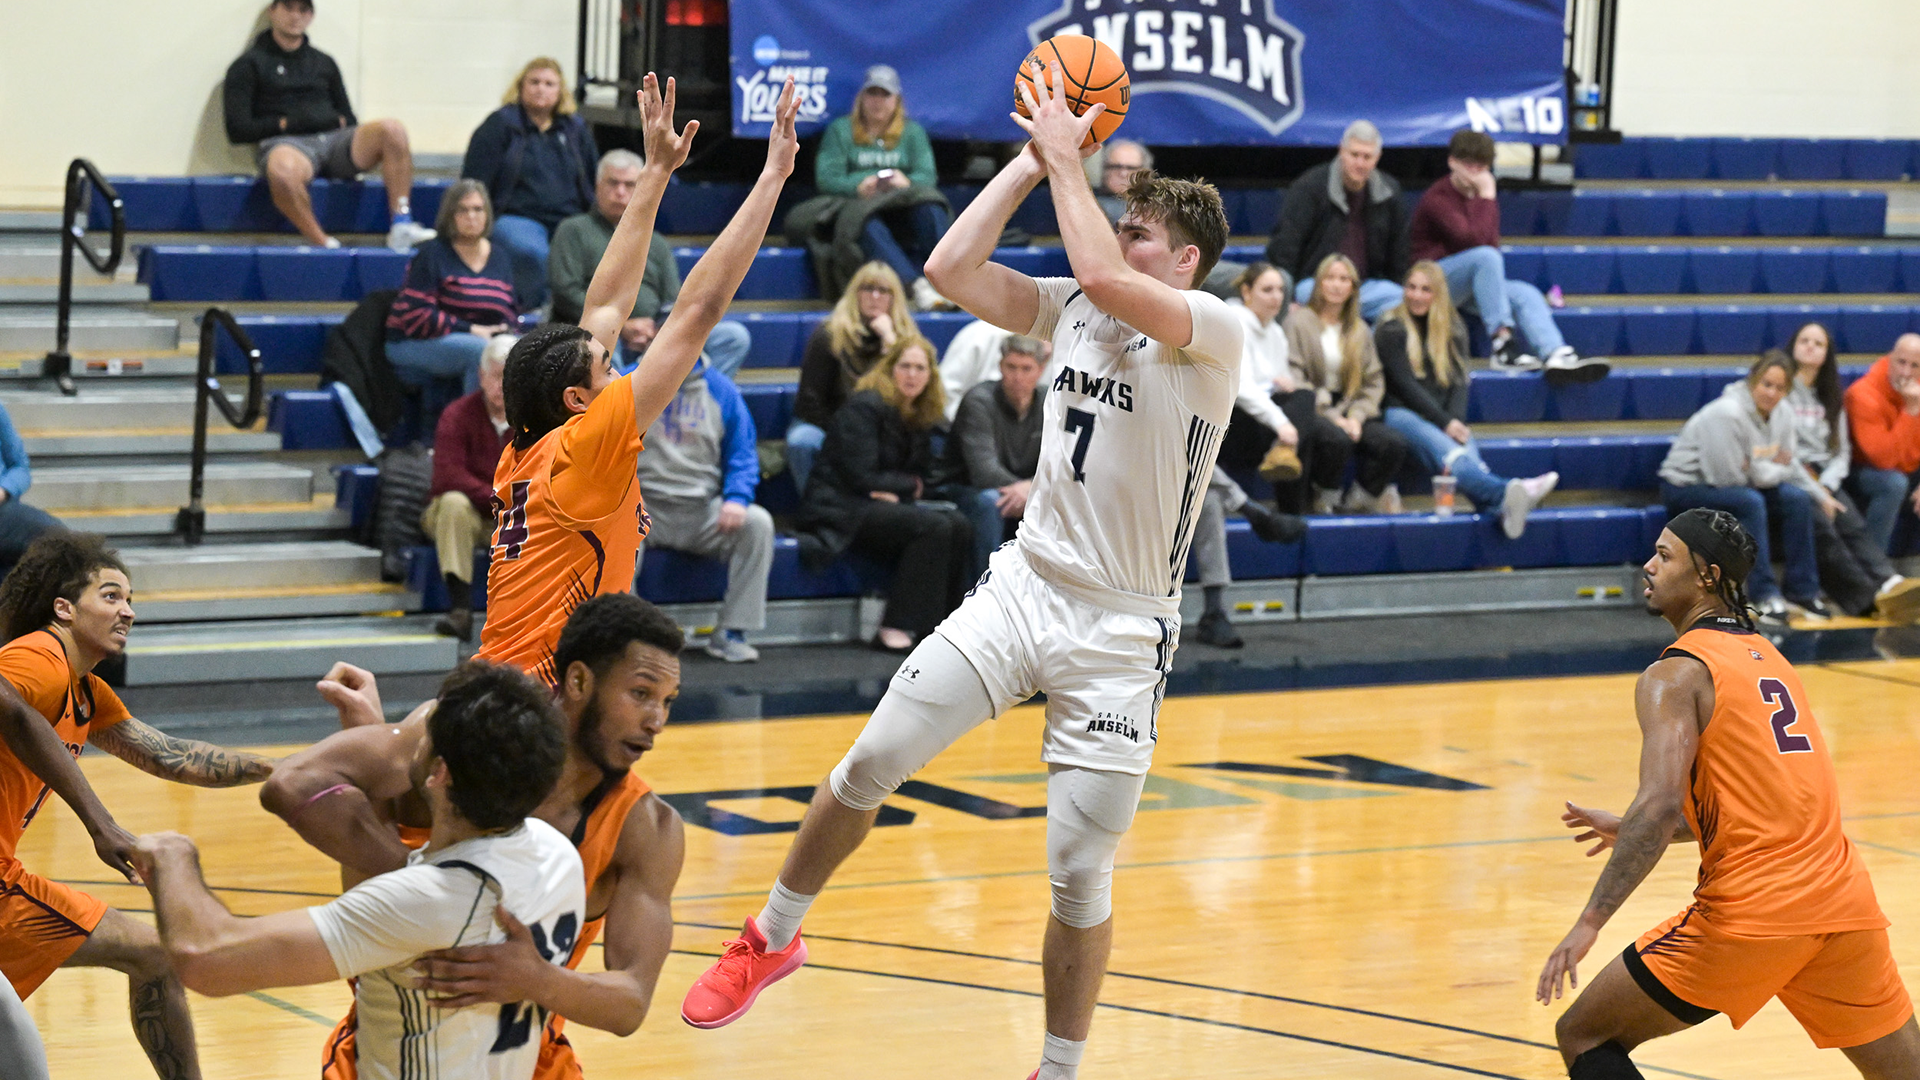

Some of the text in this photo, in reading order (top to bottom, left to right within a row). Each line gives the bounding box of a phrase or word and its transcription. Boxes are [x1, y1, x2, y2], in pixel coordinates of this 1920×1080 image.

[1054, 10, 1291, 106] NSELM
[1063, 406, 1096, 486] 7
[1086, 719, 1139, 744] ANSELM
[1097, 711, 1135, 726] SAINT
[1758, 677, 1814, 754] 2
